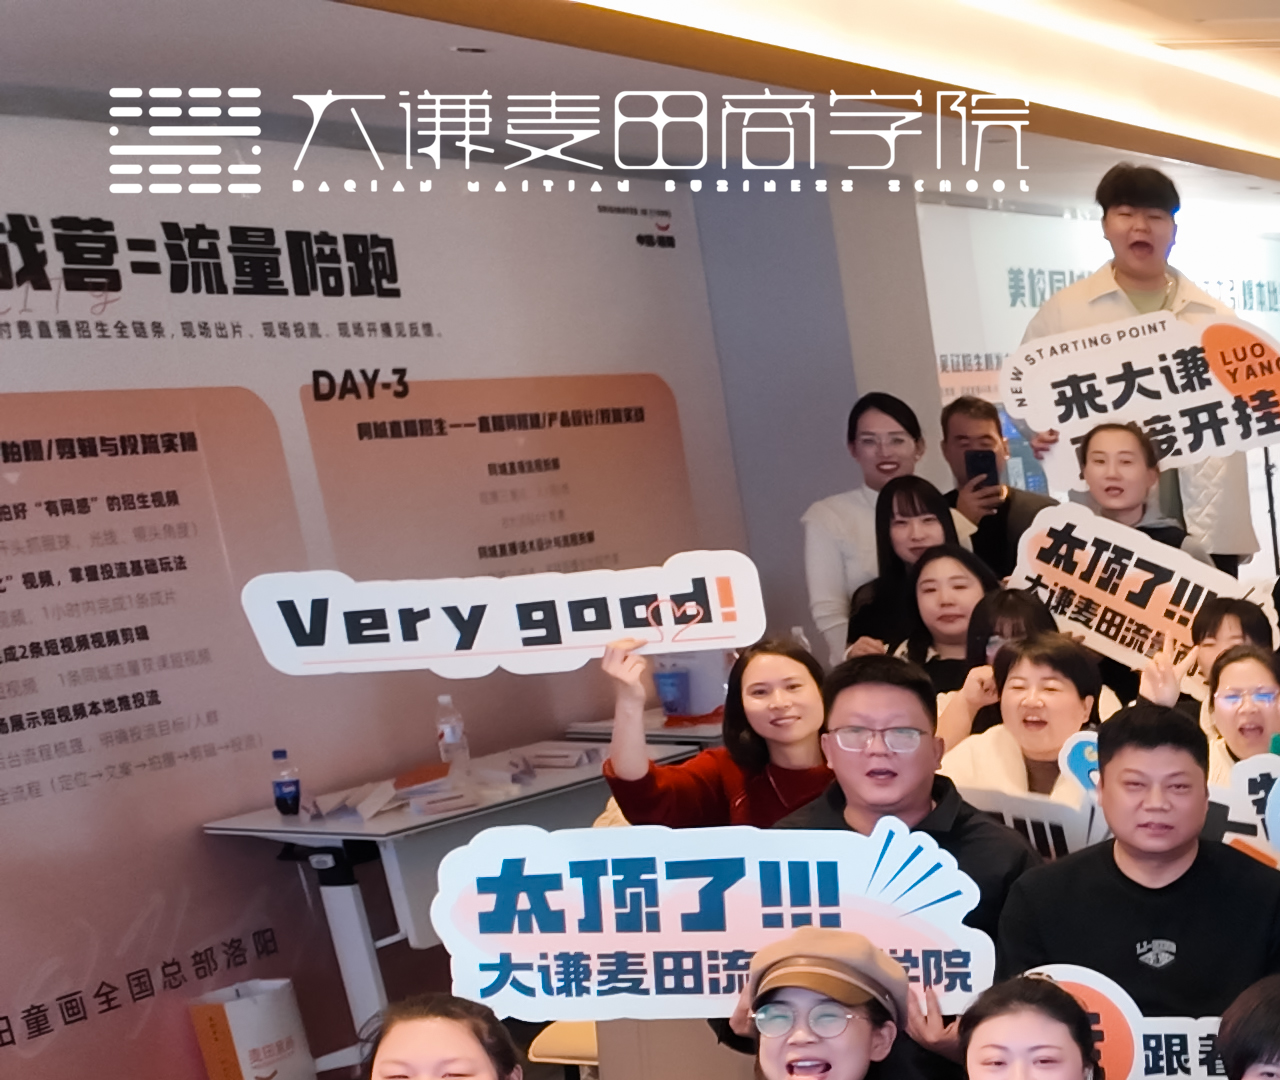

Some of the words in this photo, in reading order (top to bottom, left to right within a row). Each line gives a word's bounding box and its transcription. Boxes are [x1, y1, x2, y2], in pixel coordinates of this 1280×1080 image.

[312, 368, 411, 402] DAY-3
[1010, 366, 1028, 408] NEW
[1024, 334, 1112, 366] STARTING
[1116, 320, 1169, 342] POINT
[1051, 346, 1213, 424] 来大谦
[1219, 342, 1267, 366] LUO
[277, 597, 488, 651] Very
[515, 576, 738, 646] good!
[1024, 573, 1201, 677] 大谦麦田流量商
[476, 856, 842, 935] 太顶了!!!
[478, 948, 973, 998] 大谦麦田流学院
